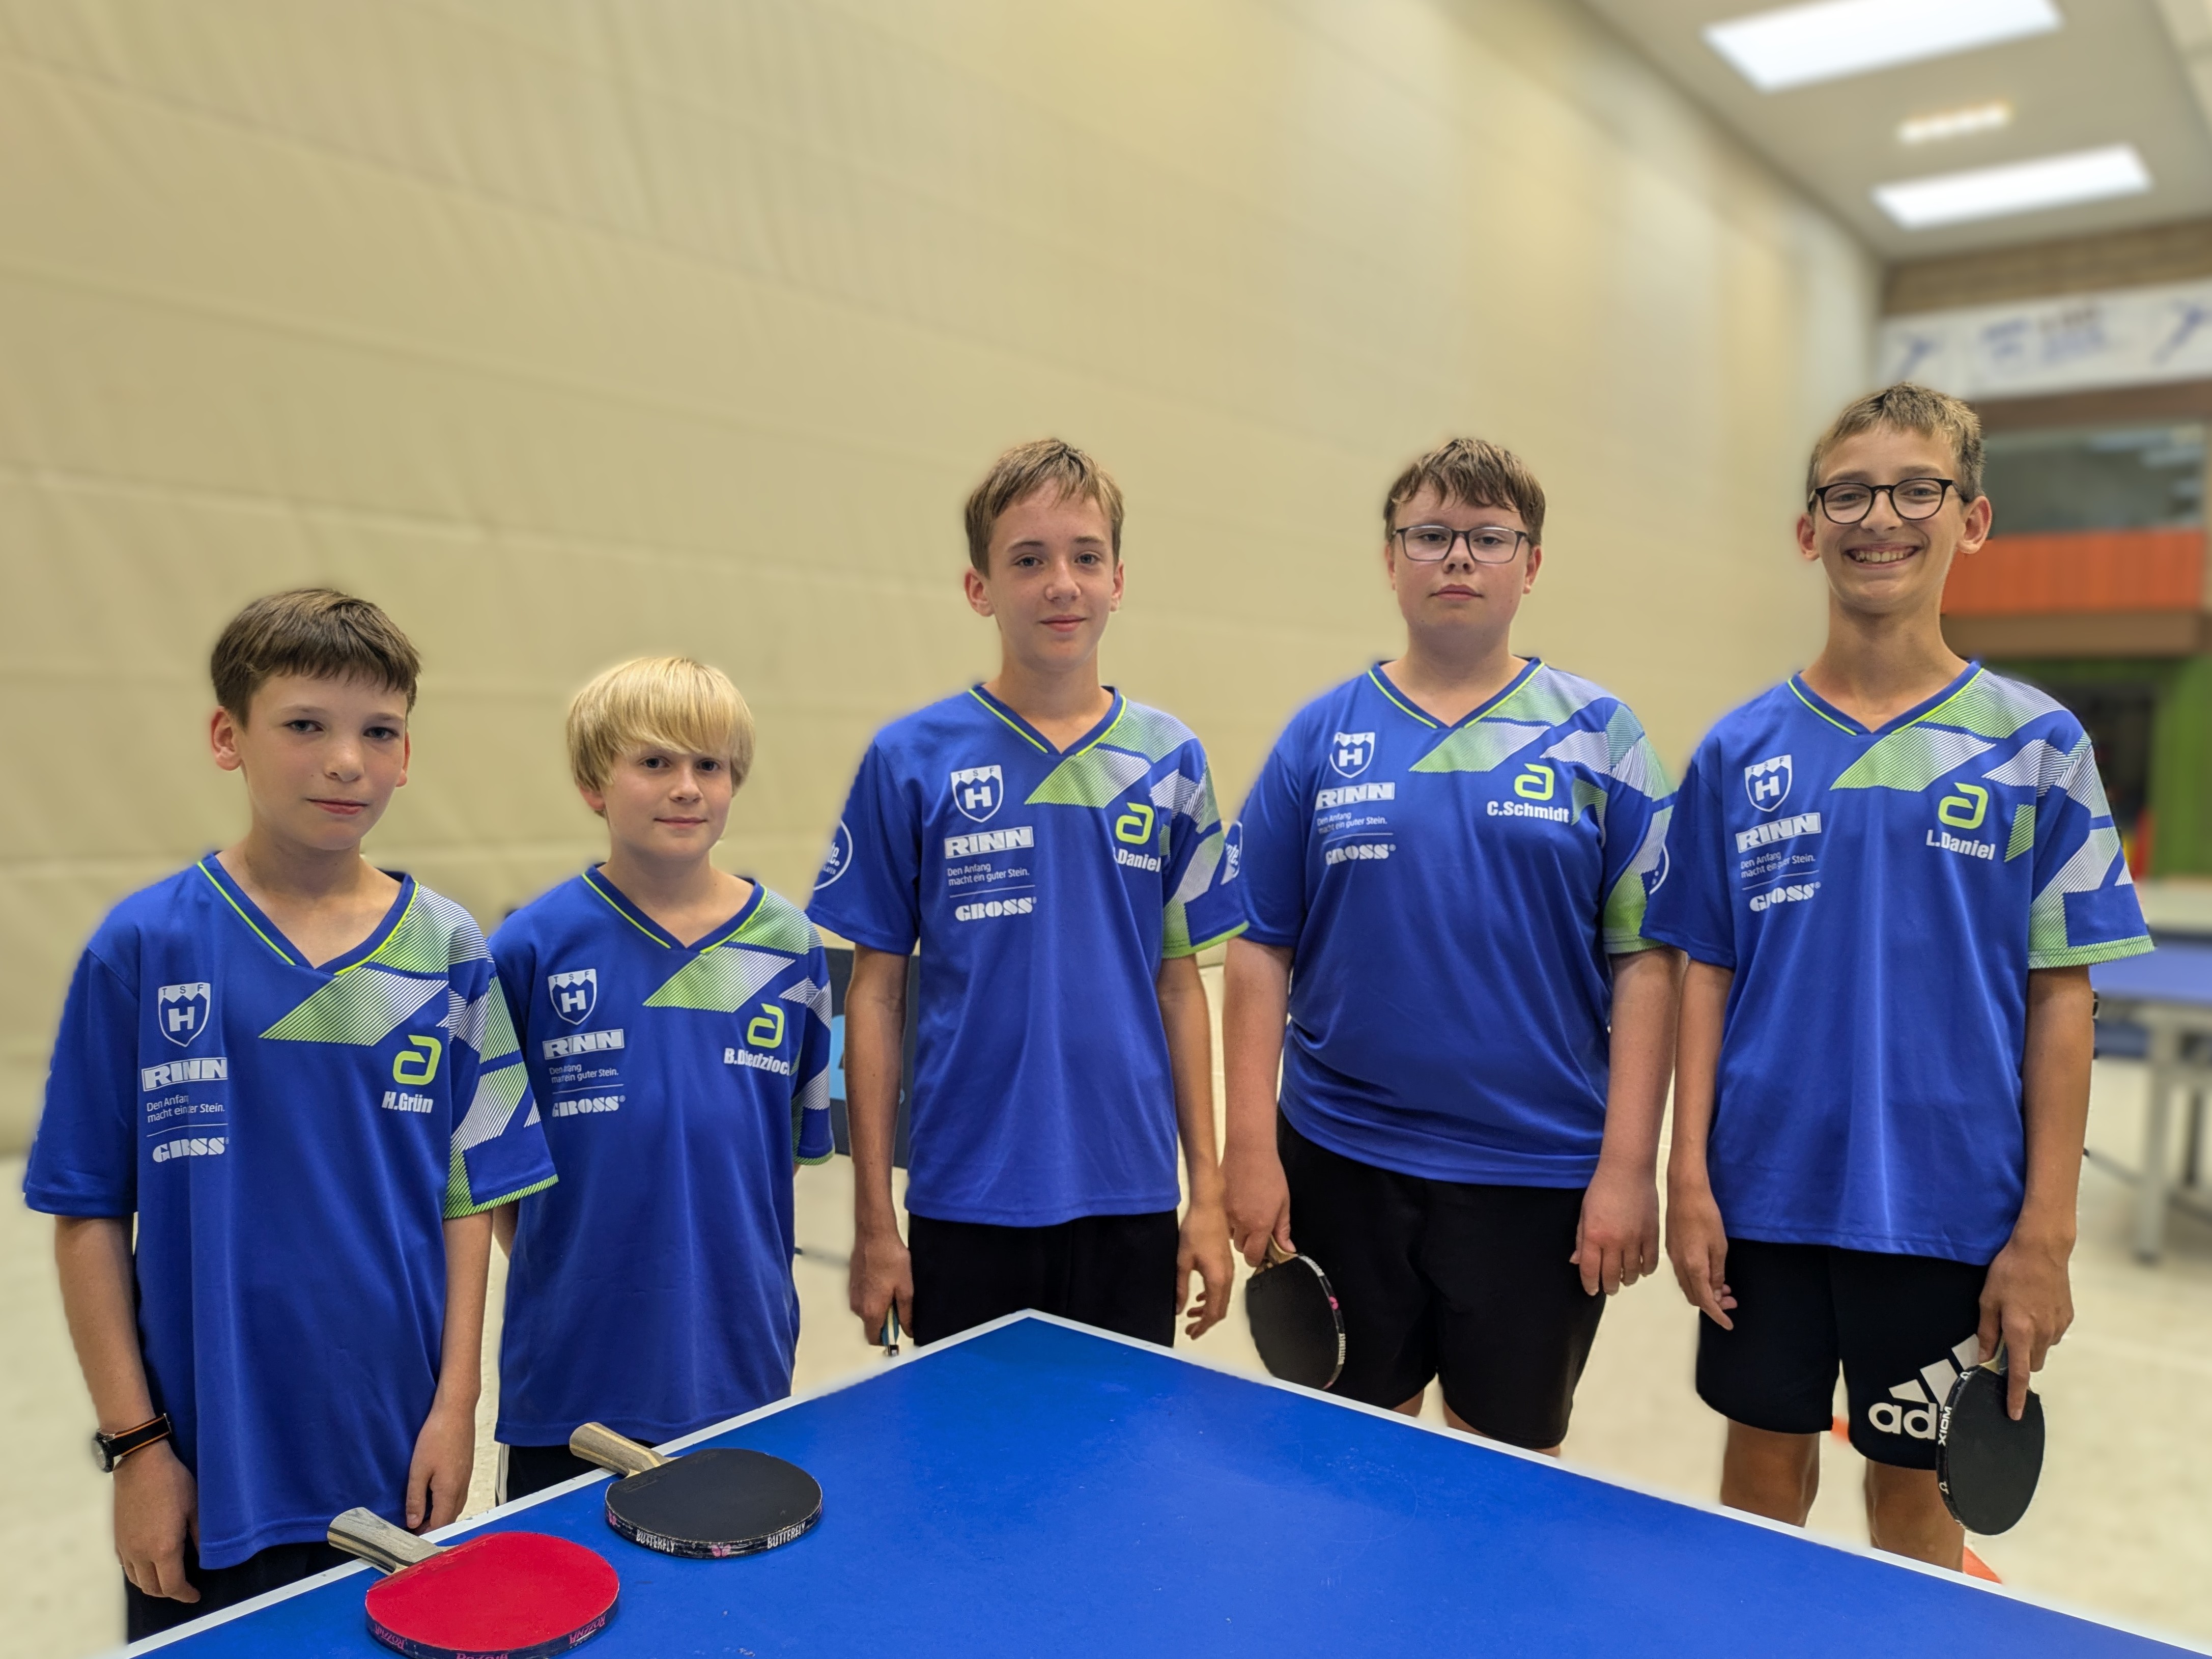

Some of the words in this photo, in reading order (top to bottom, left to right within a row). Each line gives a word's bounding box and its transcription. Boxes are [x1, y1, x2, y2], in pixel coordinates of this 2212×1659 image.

[1339, 748, 1363, 767] H
[965, 786, 992, 809] H
[1316, 783, 1394, 810] RINN
[1755, 775, 1780, 801] H
[1487, 800, 1569, 823] C.Schmidt
[946, 828, 1032, 857] RINN
[1738, 814, 1819, 851] RINN
[1926, 829, 1996, 860] L.Daniel
[947, 867, 963, 877] Den
[964, 863, 991, 874] Anfang
[1116, 848, 1161, 872] Daniel
[1741, 865, 1766, 879] macht
[1792, 853, 1816, 864] Stein.
[1756, 852, 1781, 865] Anfang
[948, 875, 973, 886] macht
[973, 873, 985, 882] ein
[986, 870, 1007, 882] guter
[1007, 867, 1030, 878] Stein.
[955, 897, 1033, 921] GROSS
[561, 990, 586, 1013] H
[168, 1006, 195, 1032] H
[577, 1071, 597, 1081] guter
[599, 1068, 619, 1077] Stein.
[147, 1101, 163, 1112] Den
[164, 1094, 189, 1107] Anfan
[147, 1108, 173, 1123] macht
[174, 1105, 187, 1115] ein
[200, 1103, 225, 1113] Stein.
[381, 1091, 434, 1113] H.Grün
[1938, 1406, 1952, 1447] XIOM
[767, 1521, 806, 1549] BUTTERFLY
